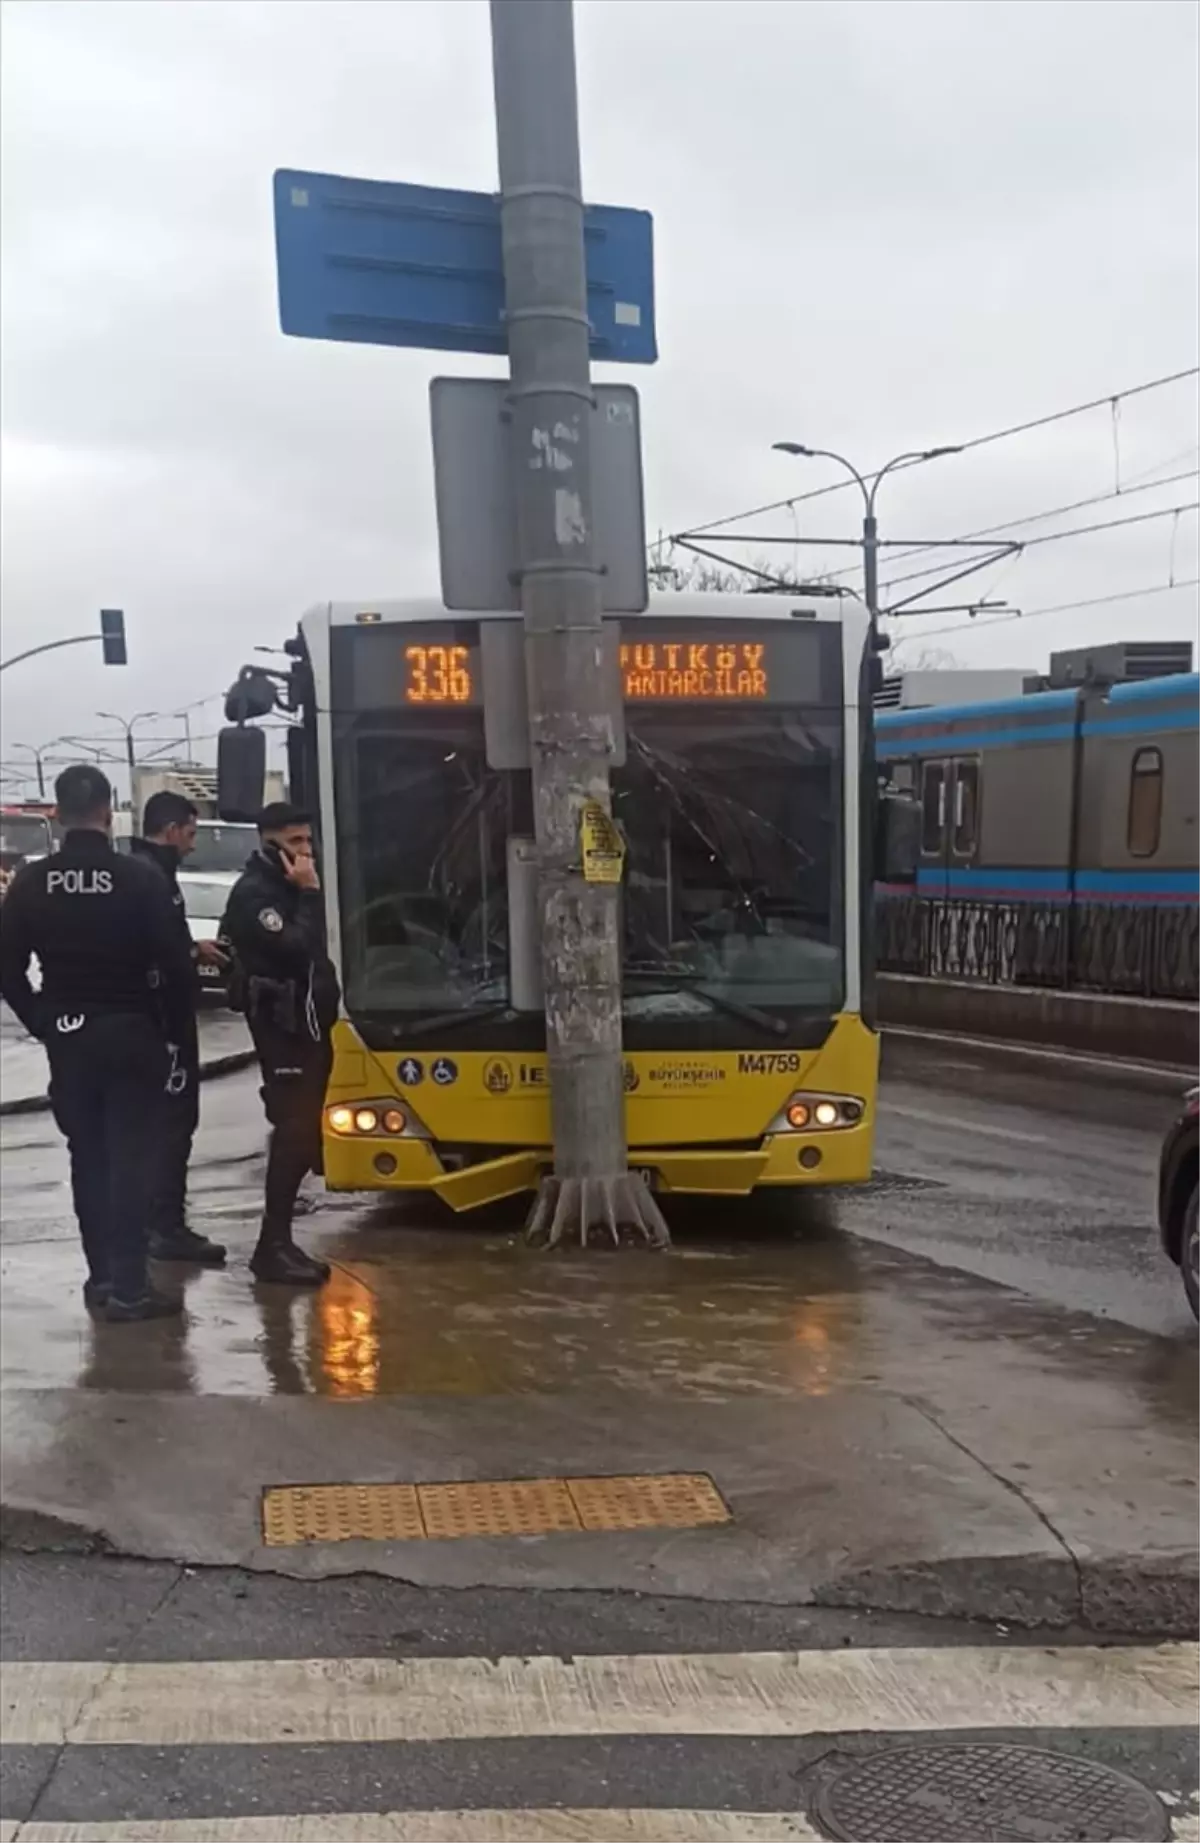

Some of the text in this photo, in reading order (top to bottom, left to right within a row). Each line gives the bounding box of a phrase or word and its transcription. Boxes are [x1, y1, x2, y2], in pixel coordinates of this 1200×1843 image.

[405, 645, 469, 700] 336
[626, 670, 767, 696] ANTARCILAR
[520, 1063, 546, 1082] İE
[738, 1053, 801, 1075] M4759
